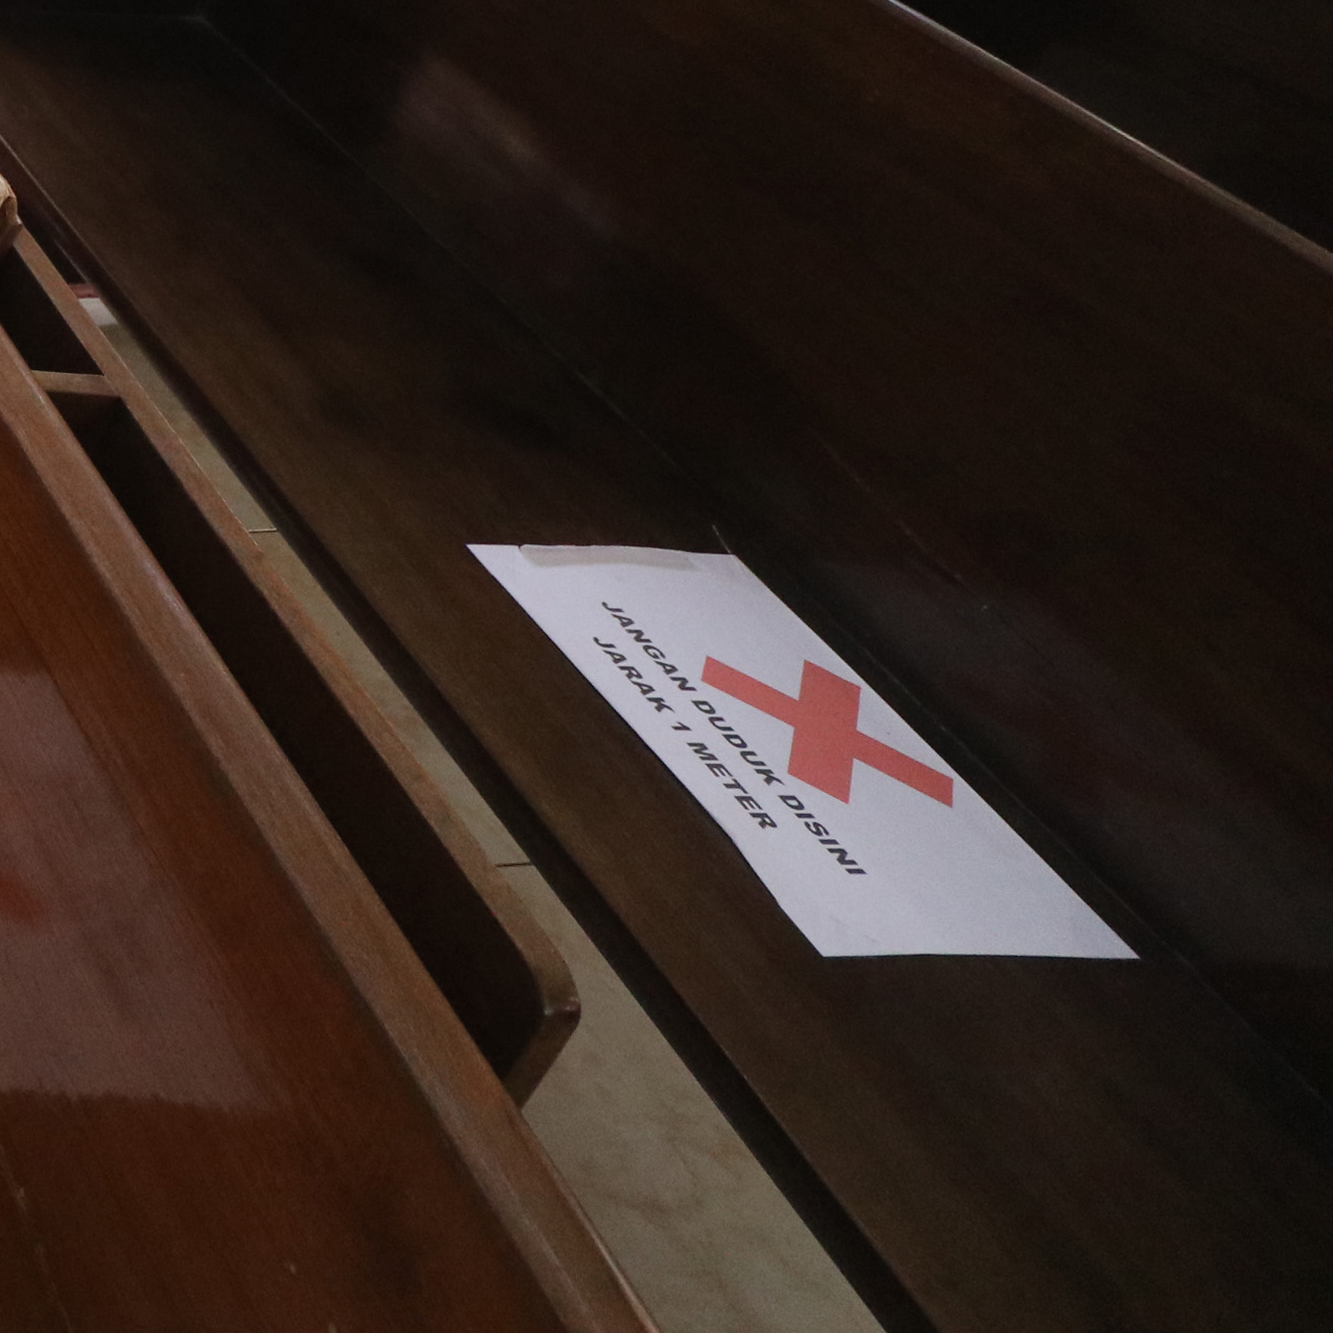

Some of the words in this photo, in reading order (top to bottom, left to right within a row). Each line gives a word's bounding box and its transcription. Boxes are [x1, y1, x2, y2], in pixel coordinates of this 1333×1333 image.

[592, 636, 675, 713] JARAK
[671, 721, 692, 732] 1
[686, 742, 778, 829] METER
[601, 601, 698, 692] JANGAN
[690, 700, 785, 786] DUDUK
[777, 794, 867, 875] DISINI
